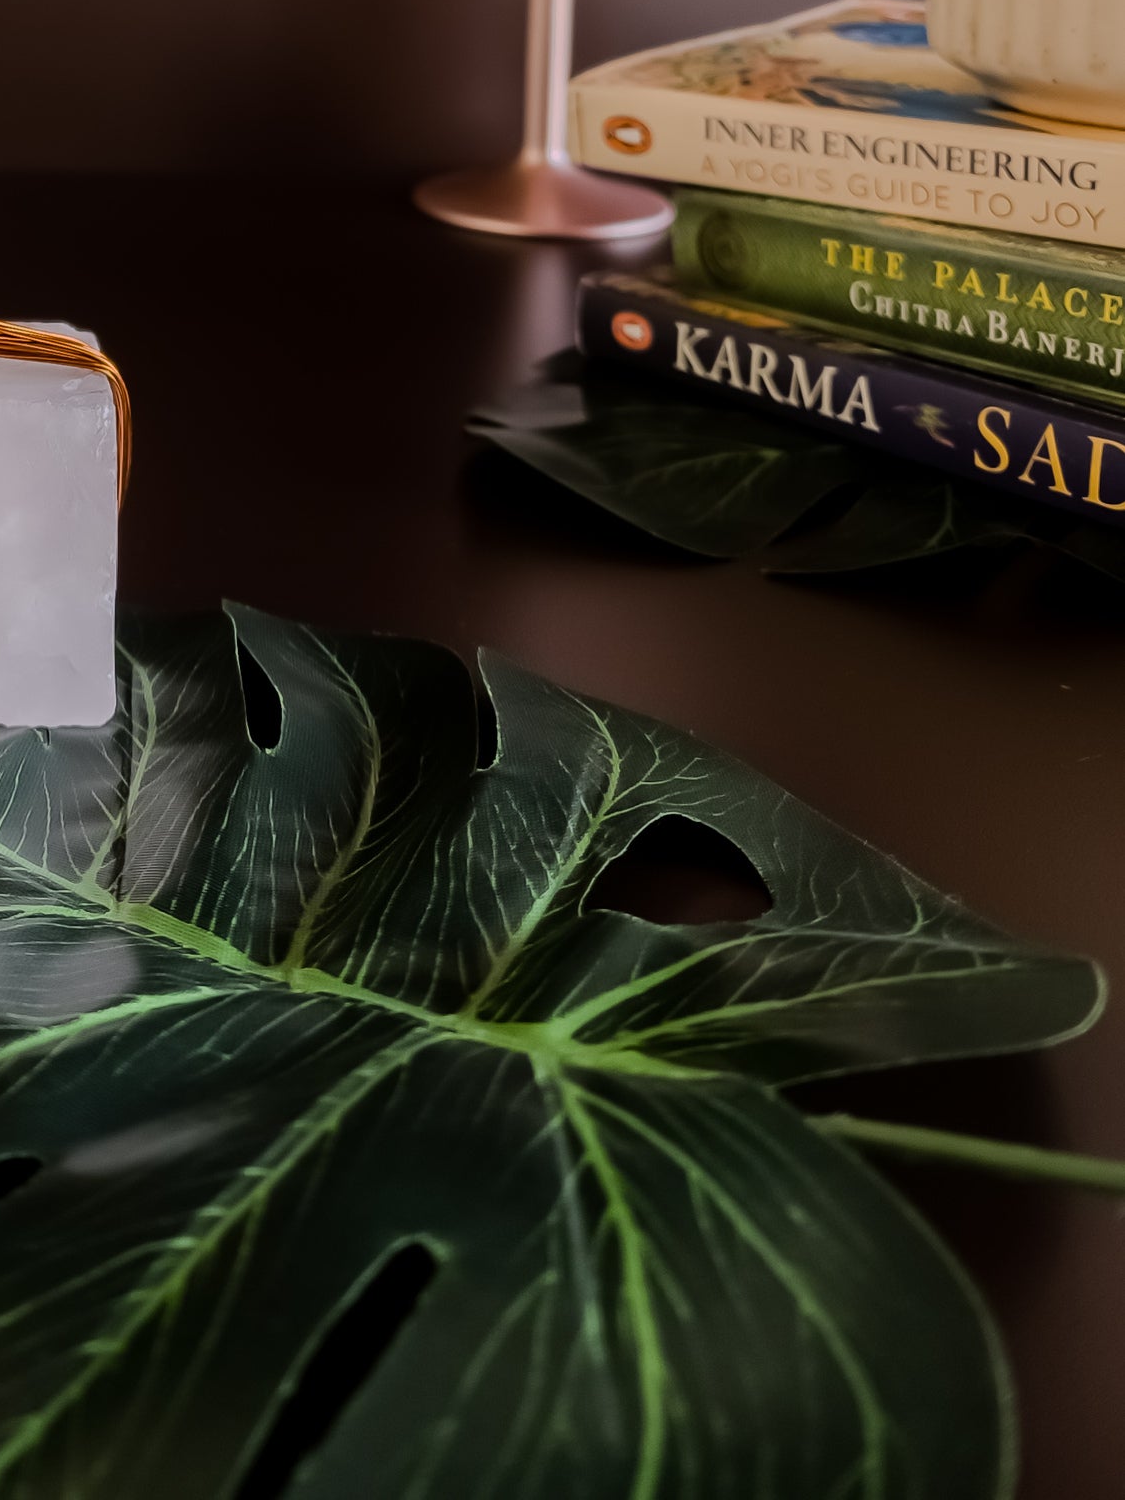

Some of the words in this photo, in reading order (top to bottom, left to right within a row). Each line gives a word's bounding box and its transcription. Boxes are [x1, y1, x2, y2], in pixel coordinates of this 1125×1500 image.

[700, 154, 717, 176] A
[729, 158, 834, 194] YOGI'S
[846, 174, 951, 211] GUIDE
[966, 188, 1014, 218] TO
[1030, 199, 1106, 232] JOY
[703, 116, 810, 154] INNER
[822, 130, 1098, 190] ENGINEERING
[821, 238, 906, 281] THE
[932, 260, 1124, 325] PALACE
[674, 321, 881, 433] KARMA
